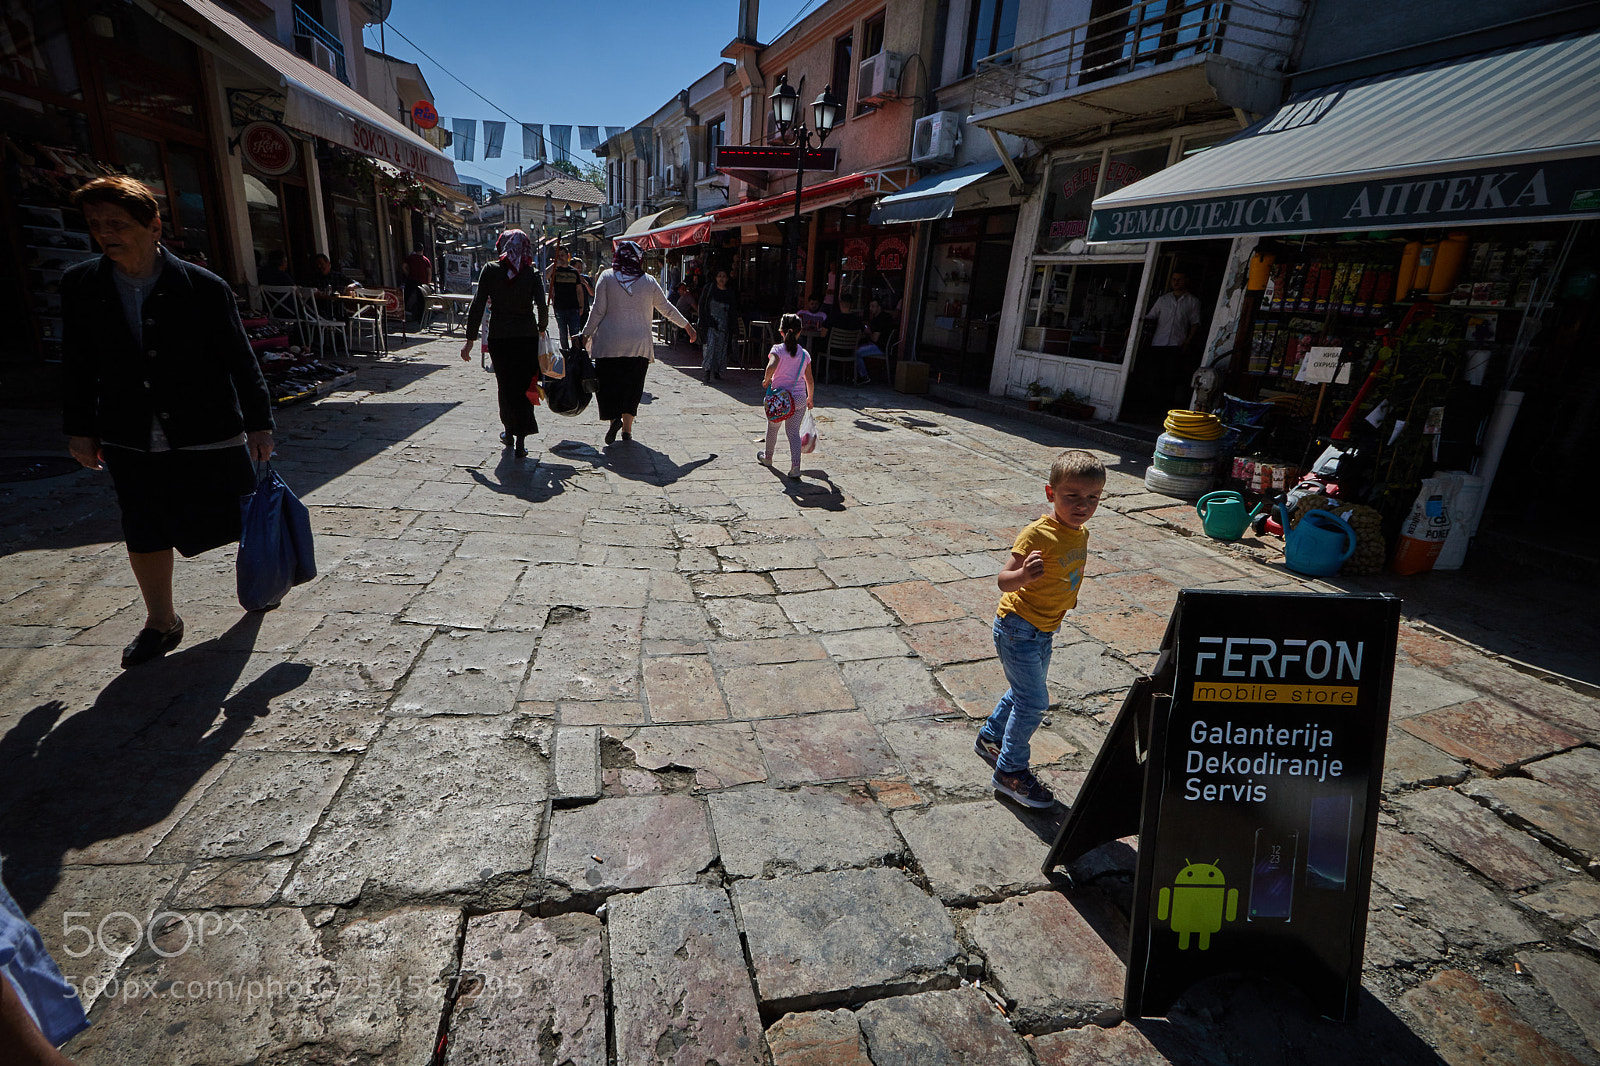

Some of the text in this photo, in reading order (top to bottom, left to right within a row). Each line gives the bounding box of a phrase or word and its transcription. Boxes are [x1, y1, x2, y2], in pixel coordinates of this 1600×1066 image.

[353, 123, 391, 159] SOKOL
[1108, 168, 1552, 236] ЗЕМЈОДЕЛСКА АПТЕКА
[1195, 636, 1364, 681] FERFON
[1197, 685, 1354, 704] mobile store
[1190, 720, 1333, 753] Galanterija
[1186, 750, 1343, 782] Dekodiranje
[1184, 777, 1267, 802] Servis
[1270, 854, 1281, 864] 23
[1271, 845, 1281, 855] 12
